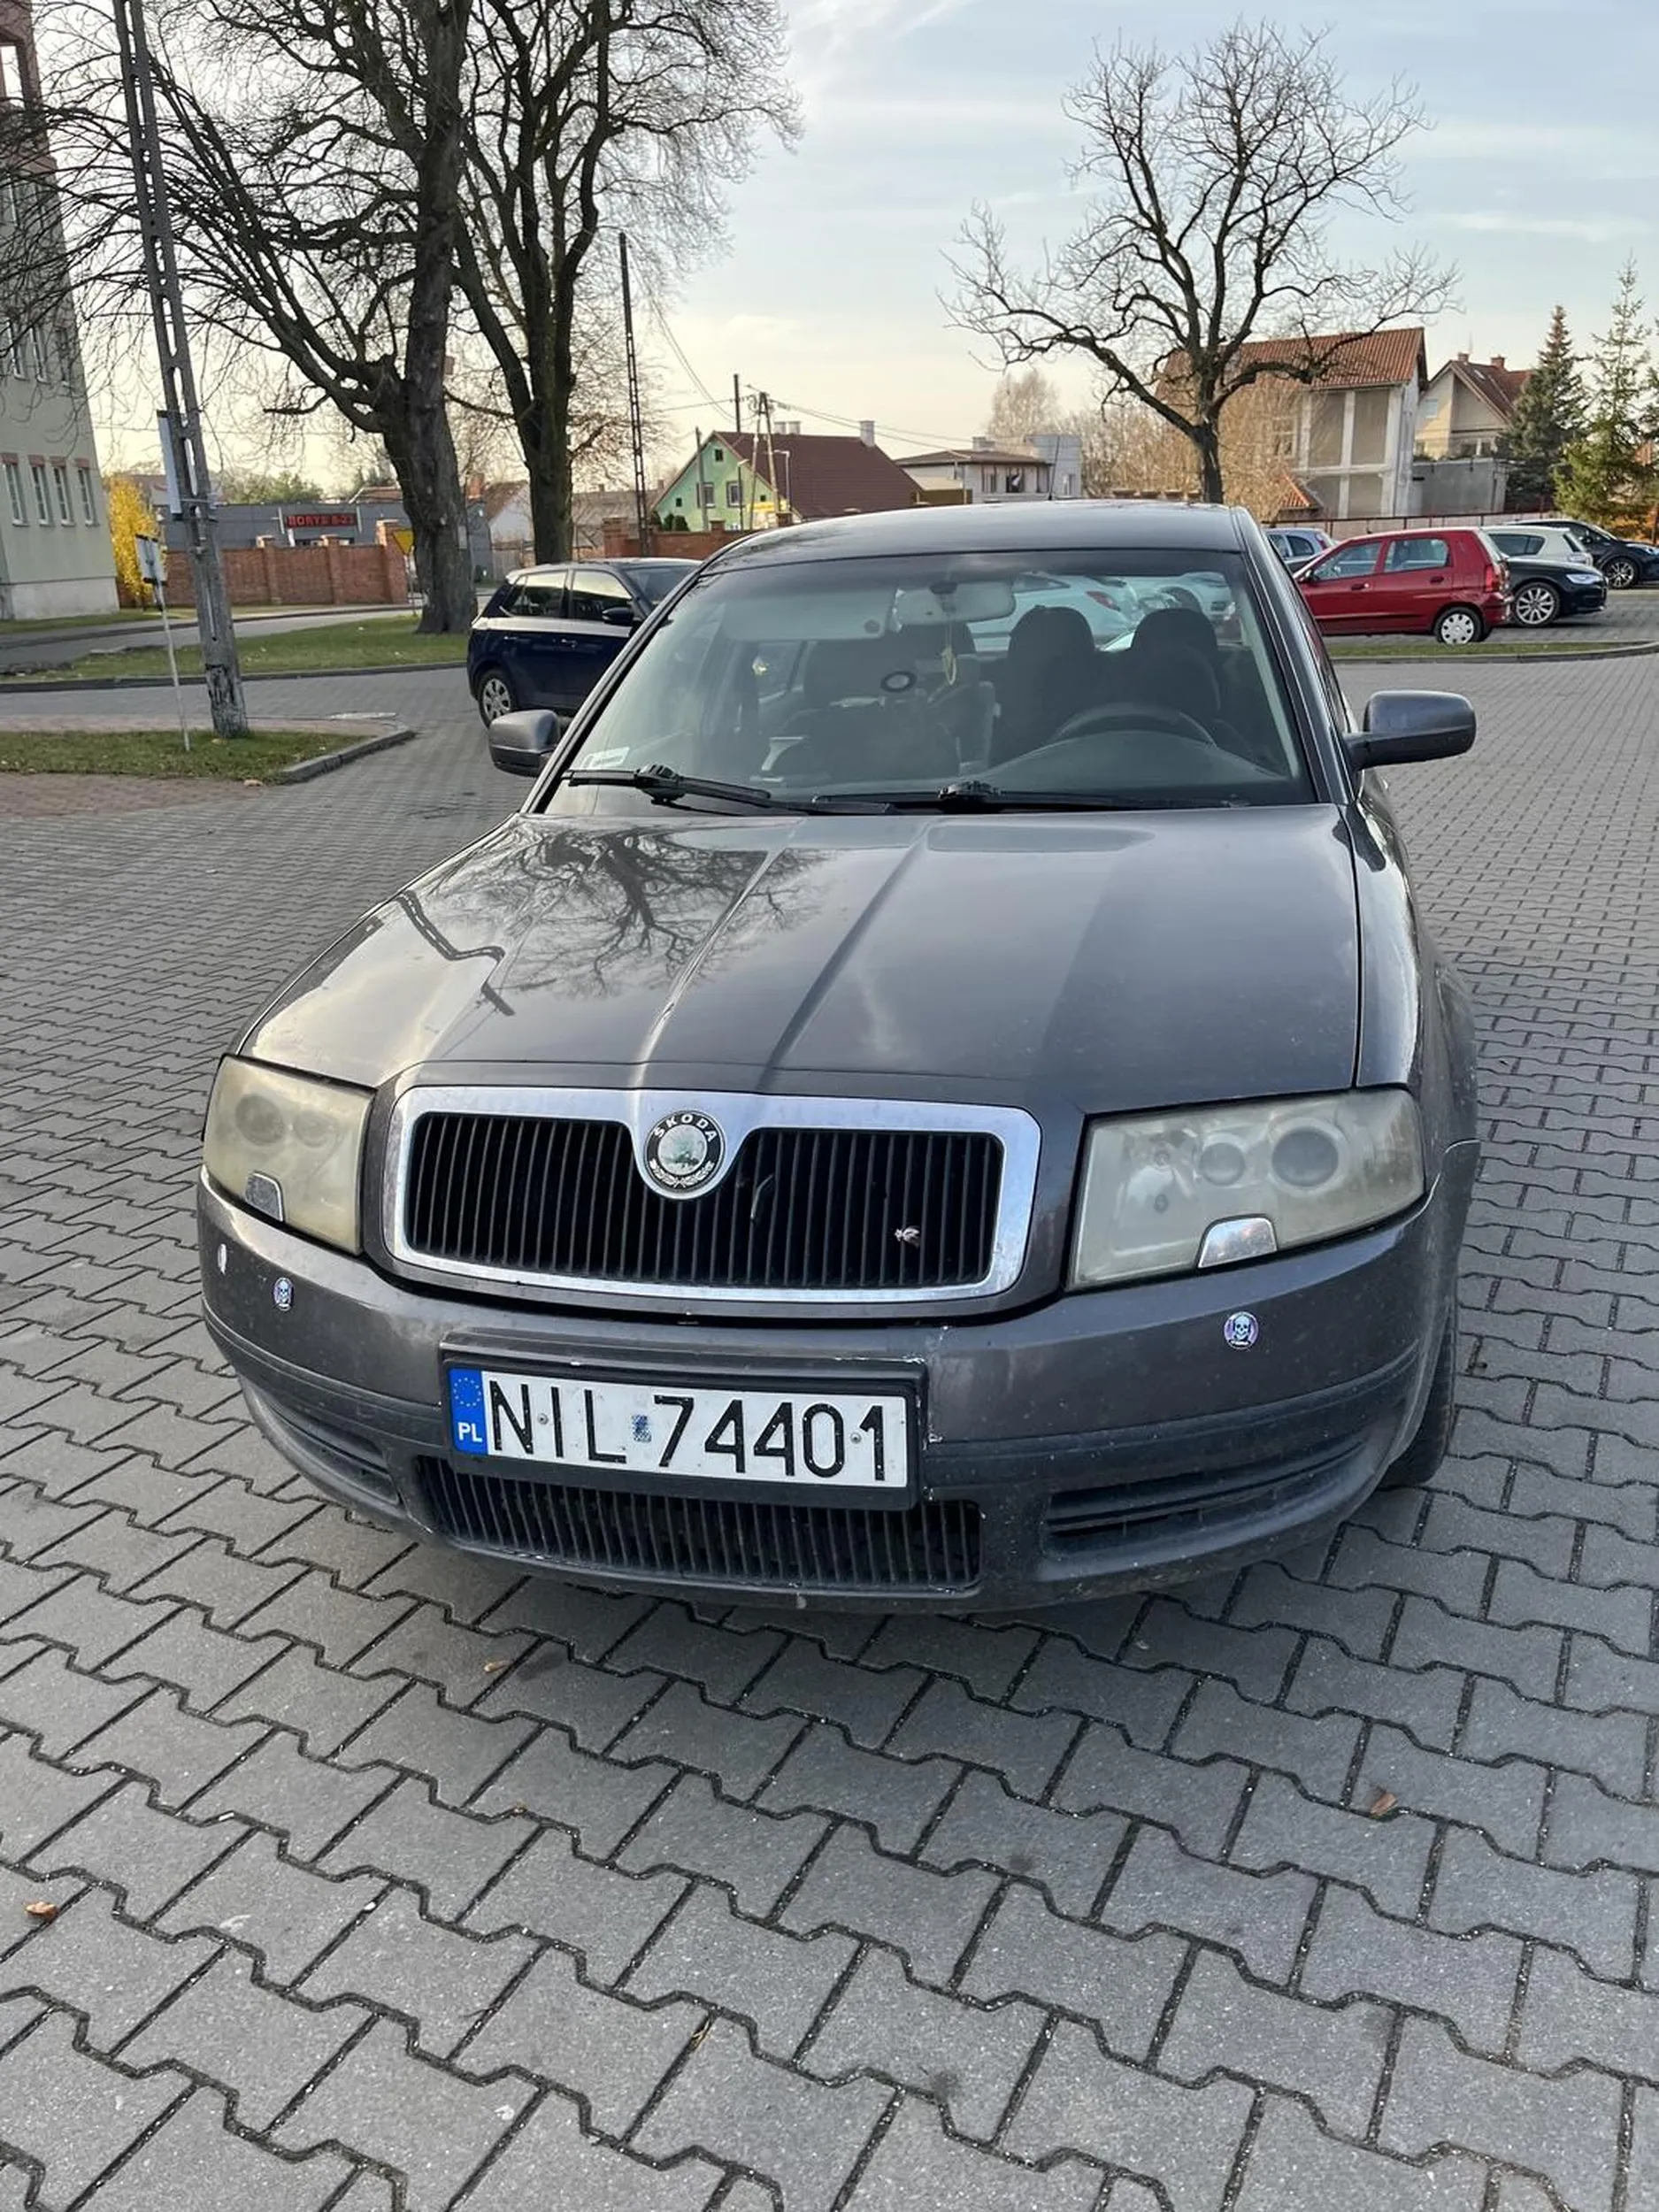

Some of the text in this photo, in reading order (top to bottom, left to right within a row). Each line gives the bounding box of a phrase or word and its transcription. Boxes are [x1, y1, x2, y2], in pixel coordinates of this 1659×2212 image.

[457, 1422, 483, 1444] PL
[489, 1379, 885, 1481] NIL 74401
